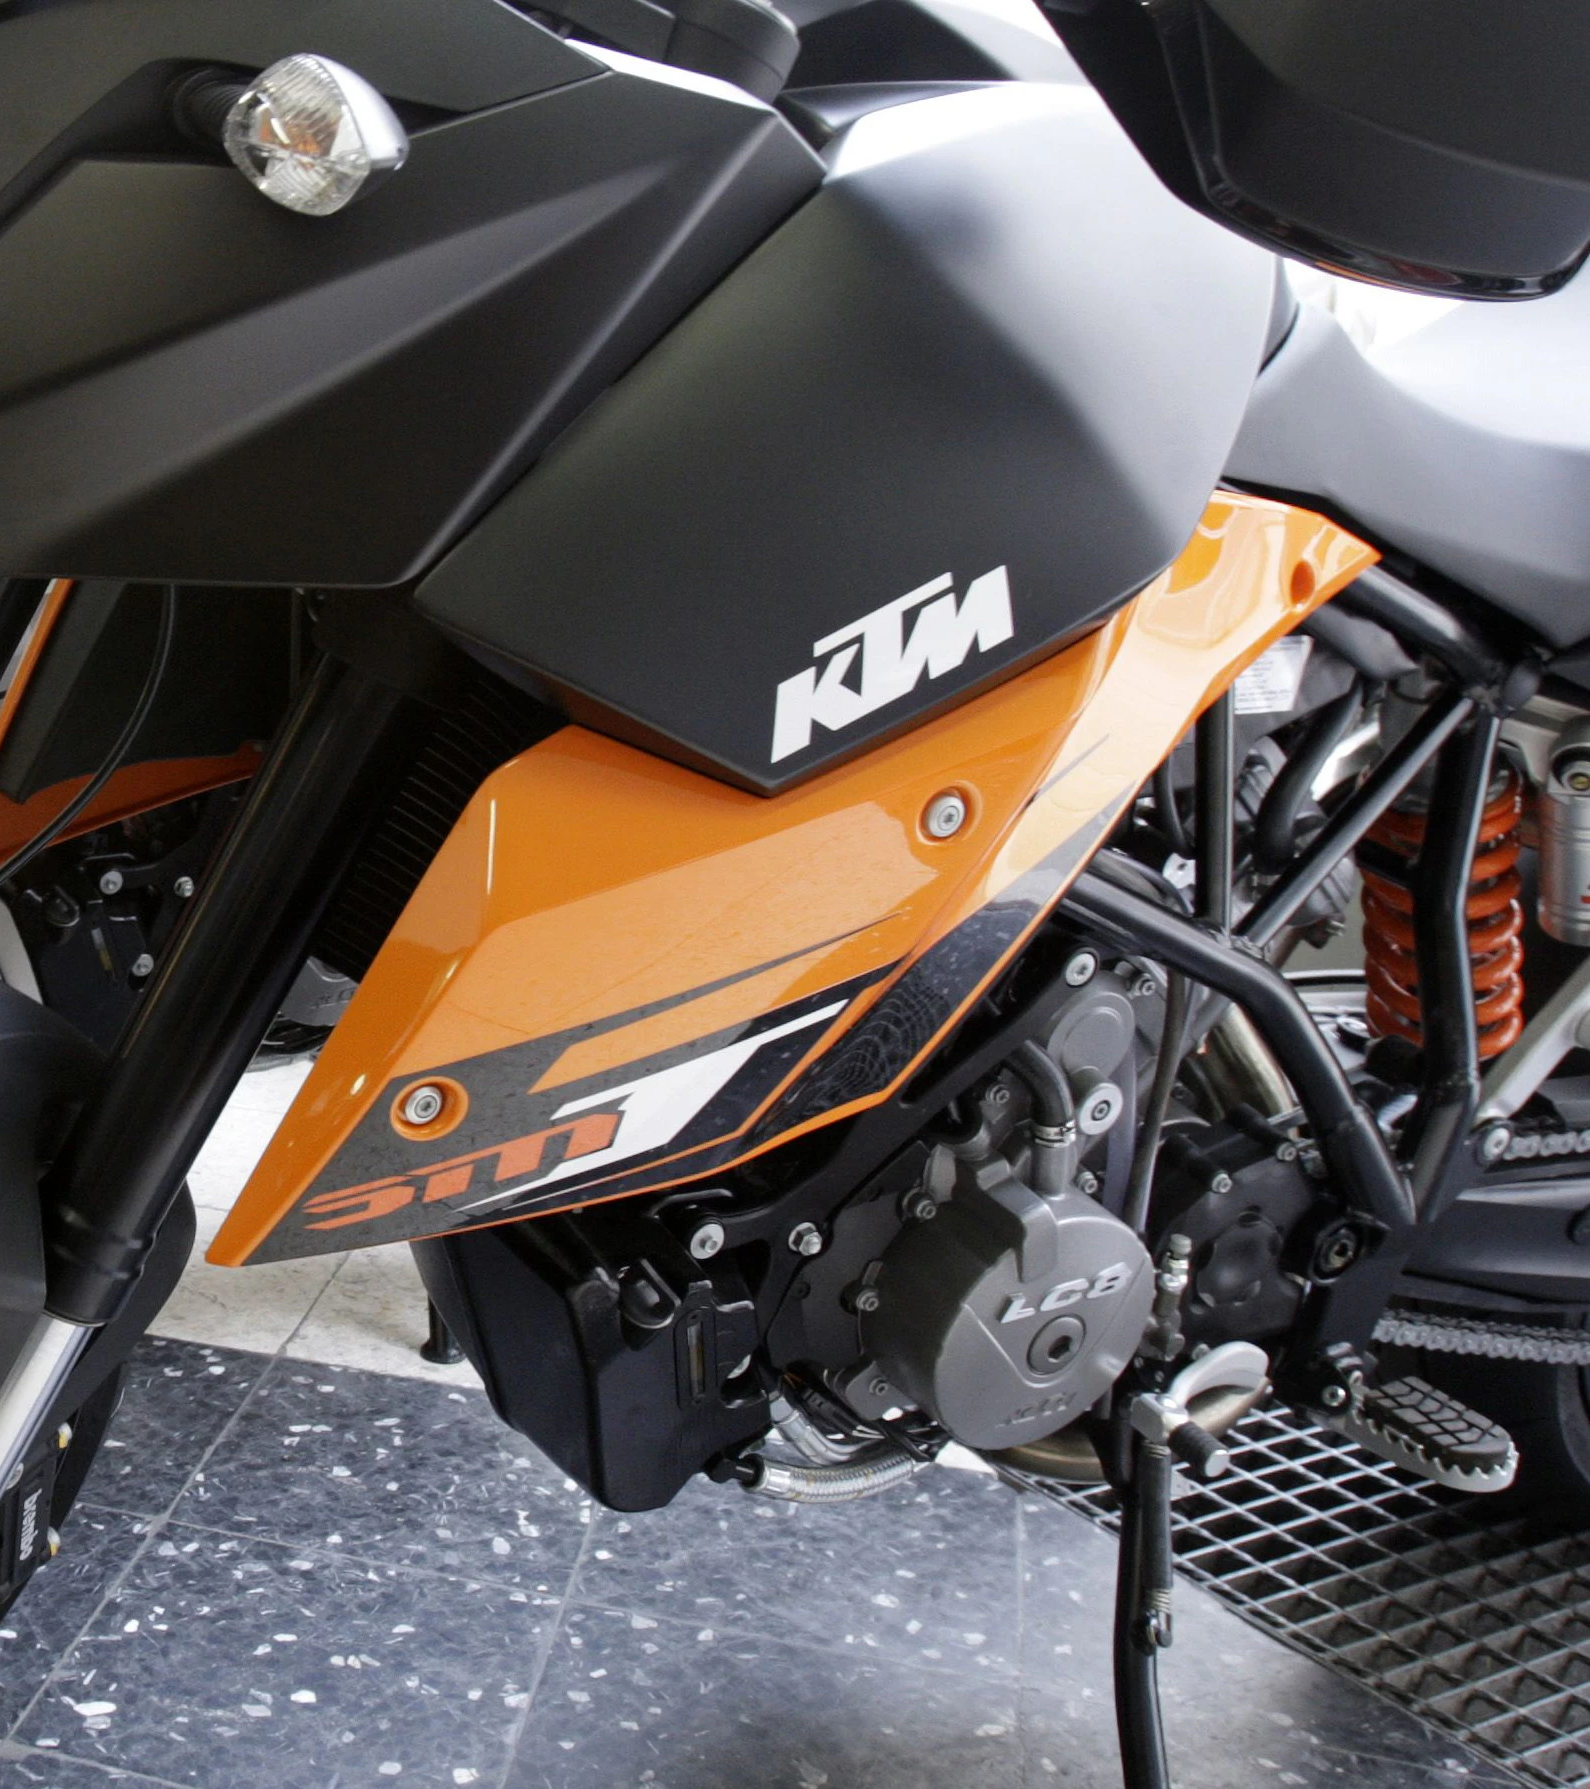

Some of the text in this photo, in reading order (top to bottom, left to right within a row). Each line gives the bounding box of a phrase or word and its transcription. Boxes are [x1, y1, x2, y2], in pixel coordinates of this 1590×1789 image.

[770, 564, 1014, 764] KTM
[997, 1261, 1133, 1325] LC8
[19, 1488, 43, 1561] brembo
